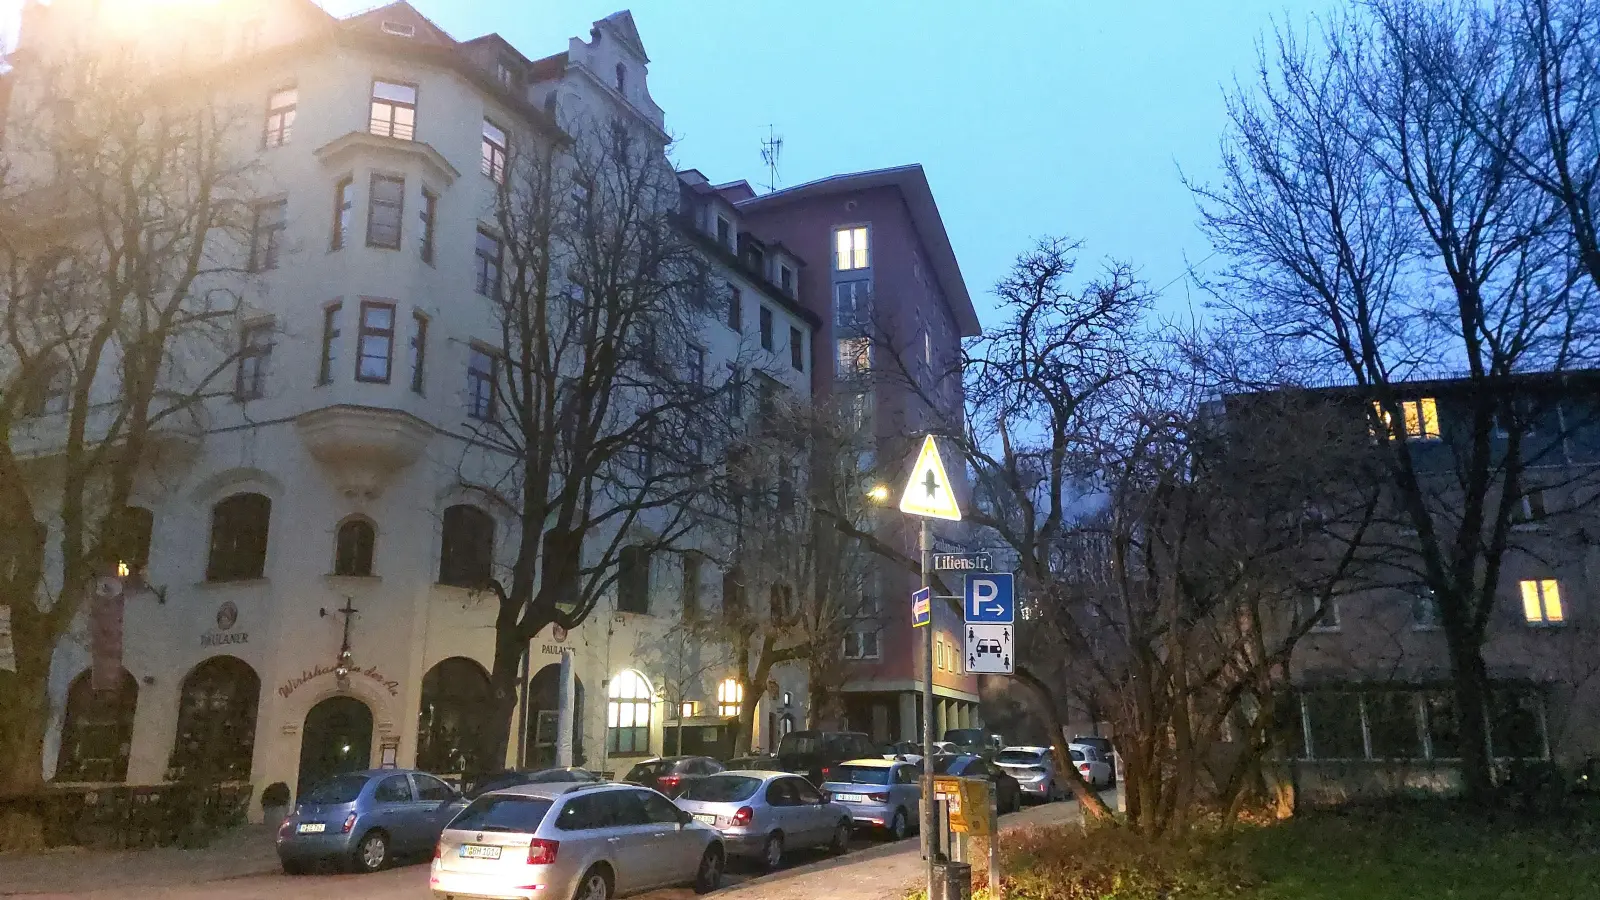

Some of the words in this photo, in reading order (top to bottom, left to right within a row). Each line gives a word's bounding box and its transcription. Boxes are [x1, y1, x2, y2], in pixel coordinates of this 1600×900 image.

[934, 555, 989, 571] Lilienstr.
[973, 579, 999, 616] P
[363, 665, 384, 682] der
[383, 680, 399, 697] Au
